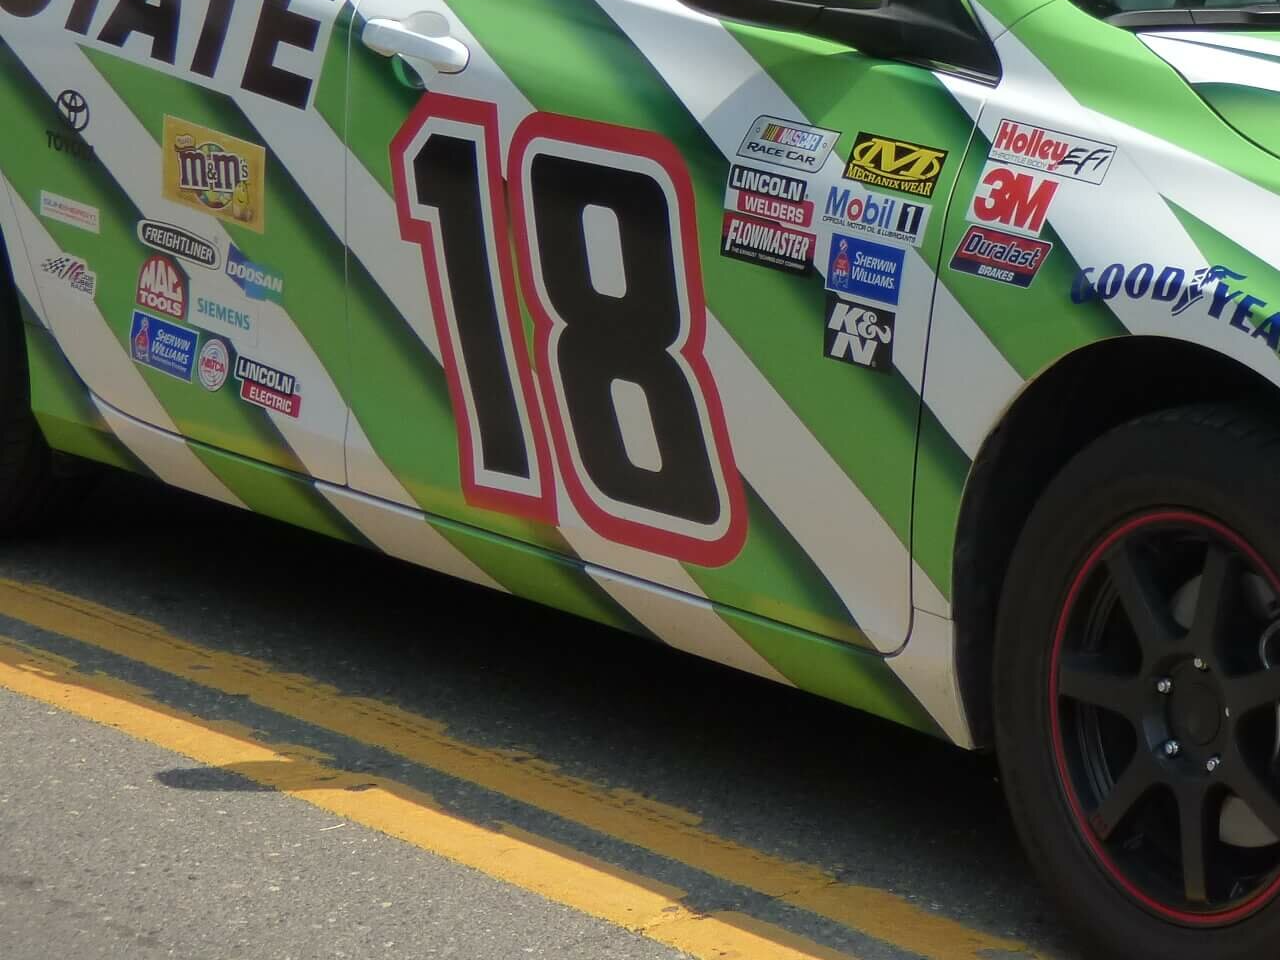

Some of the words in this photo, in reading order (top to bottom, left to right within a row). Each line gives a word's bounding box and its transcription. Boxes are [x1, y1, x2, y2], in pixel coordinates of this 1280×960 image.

[746, 141, 783, 158] RACE
[785, 151, 816, 167] CAR
[777, 126, 823, 152] NASCAR
[994, 122, 1070, 166] Holley
[732, 167, 804, 202] LINCOLN
[846, 164, 900, 190] MECHANIX
[900, 181, 933, 196] WEAR
[745, 195, 804, 224] WELDERS
[824, 186, 896, 229] Mobil
[973, 167, 1061, 233] 3M
[144, 226, 213, 262] FREIGHTLINER
[725, 218, 810, 262] FLOWMASTER
[964, 231, 1041, 269] Duralast
[227, 261, 283, 293] DOOSAN
[851, 265, 895, 290] WILLIAMS
[854, 251, 897, 275] SHERWIN
[977, 264, 1015, 282] BRAKES
[140, 259, 183, 302] MAC
[139, 291, 183, 317] TOOLS
[197, 298, 251, 330] SIEMENS
[400, 110, 735, 548] 18
[151, 341, 190, 365] WILLIAMS
[238, 359, 294, 394] LINCOLN
[249, 386, 293, 414] ELECTRIC
